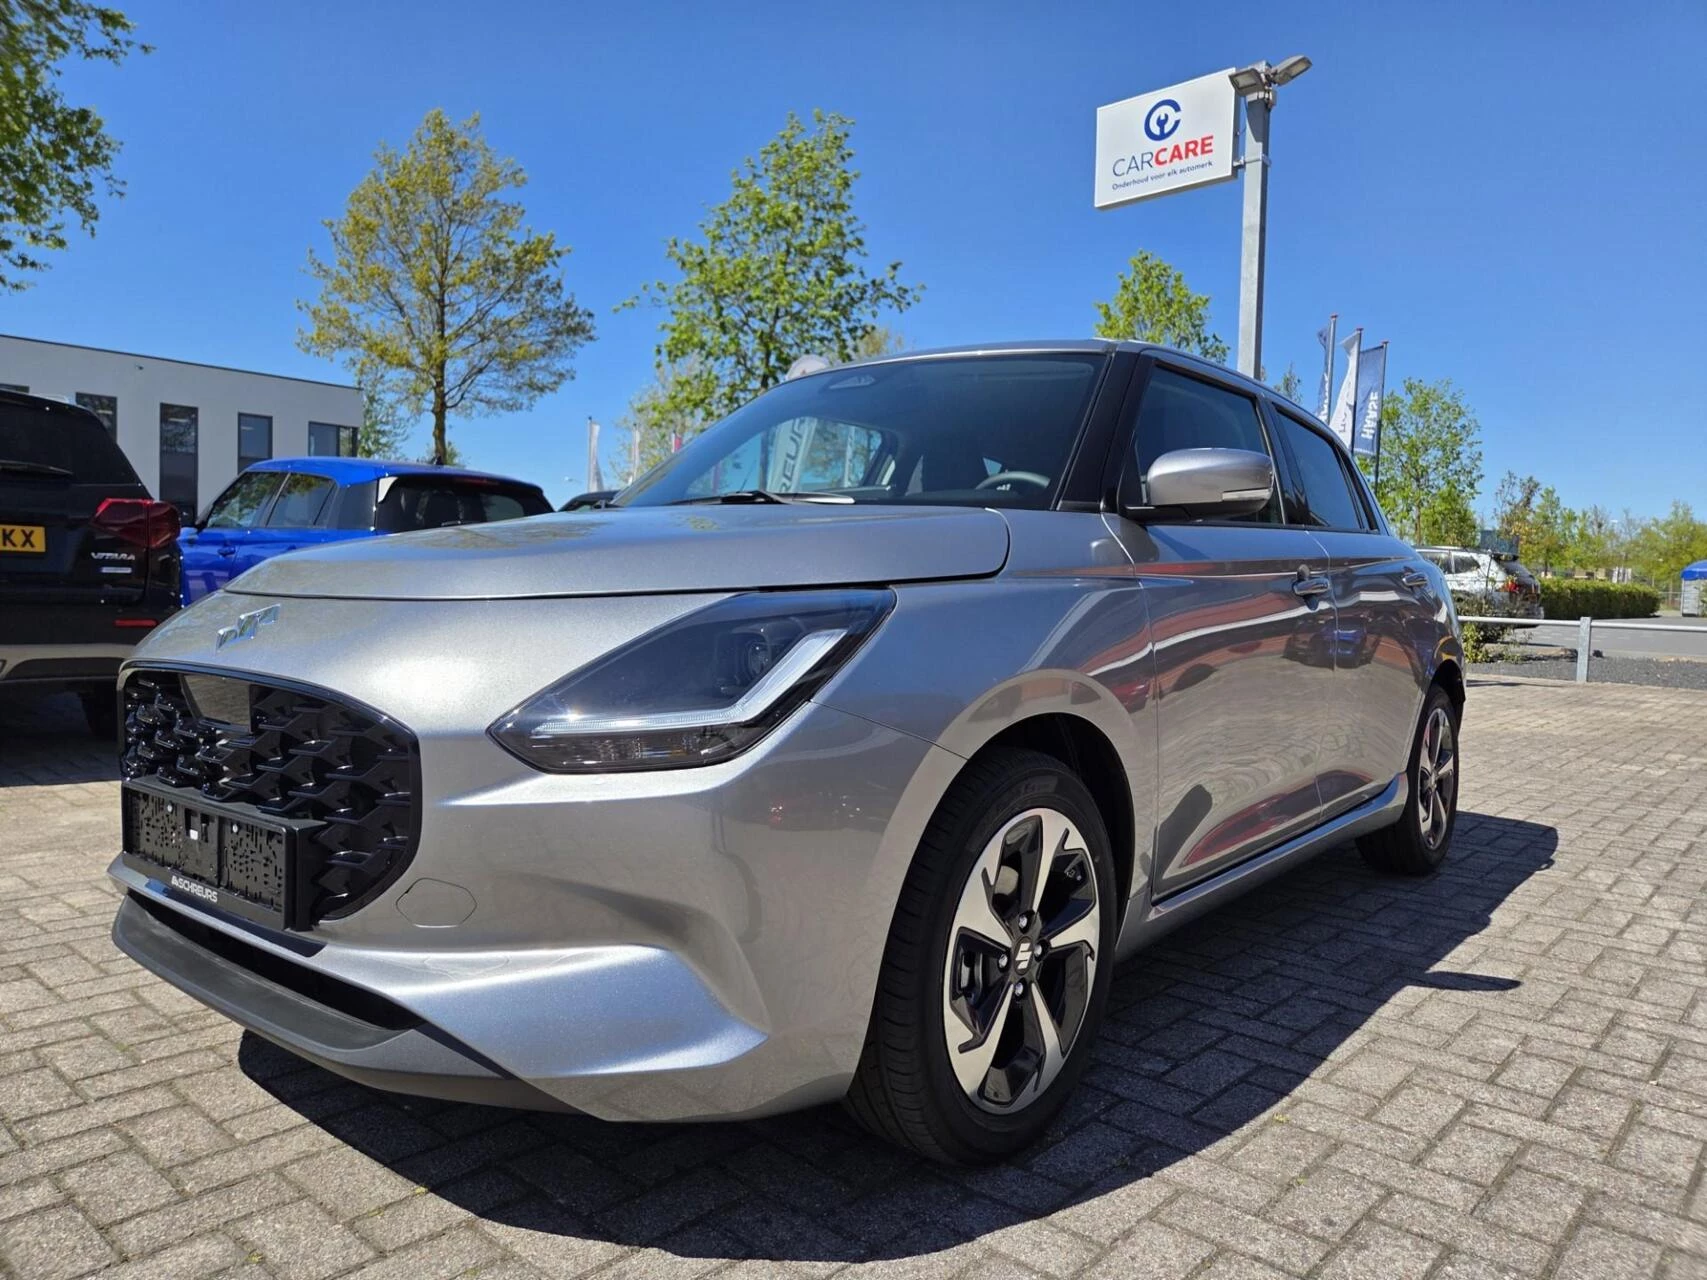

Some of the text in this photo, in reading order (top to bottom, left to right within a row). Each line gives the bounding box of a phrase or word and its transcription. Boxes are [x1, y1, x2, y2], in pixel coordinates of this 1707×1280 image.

[1112, 135, 1214, 177] CARCARE
[1112, 160, 1213, 190] Onderhoud voor elk automerk
[2, 528, 35, 548] KX
